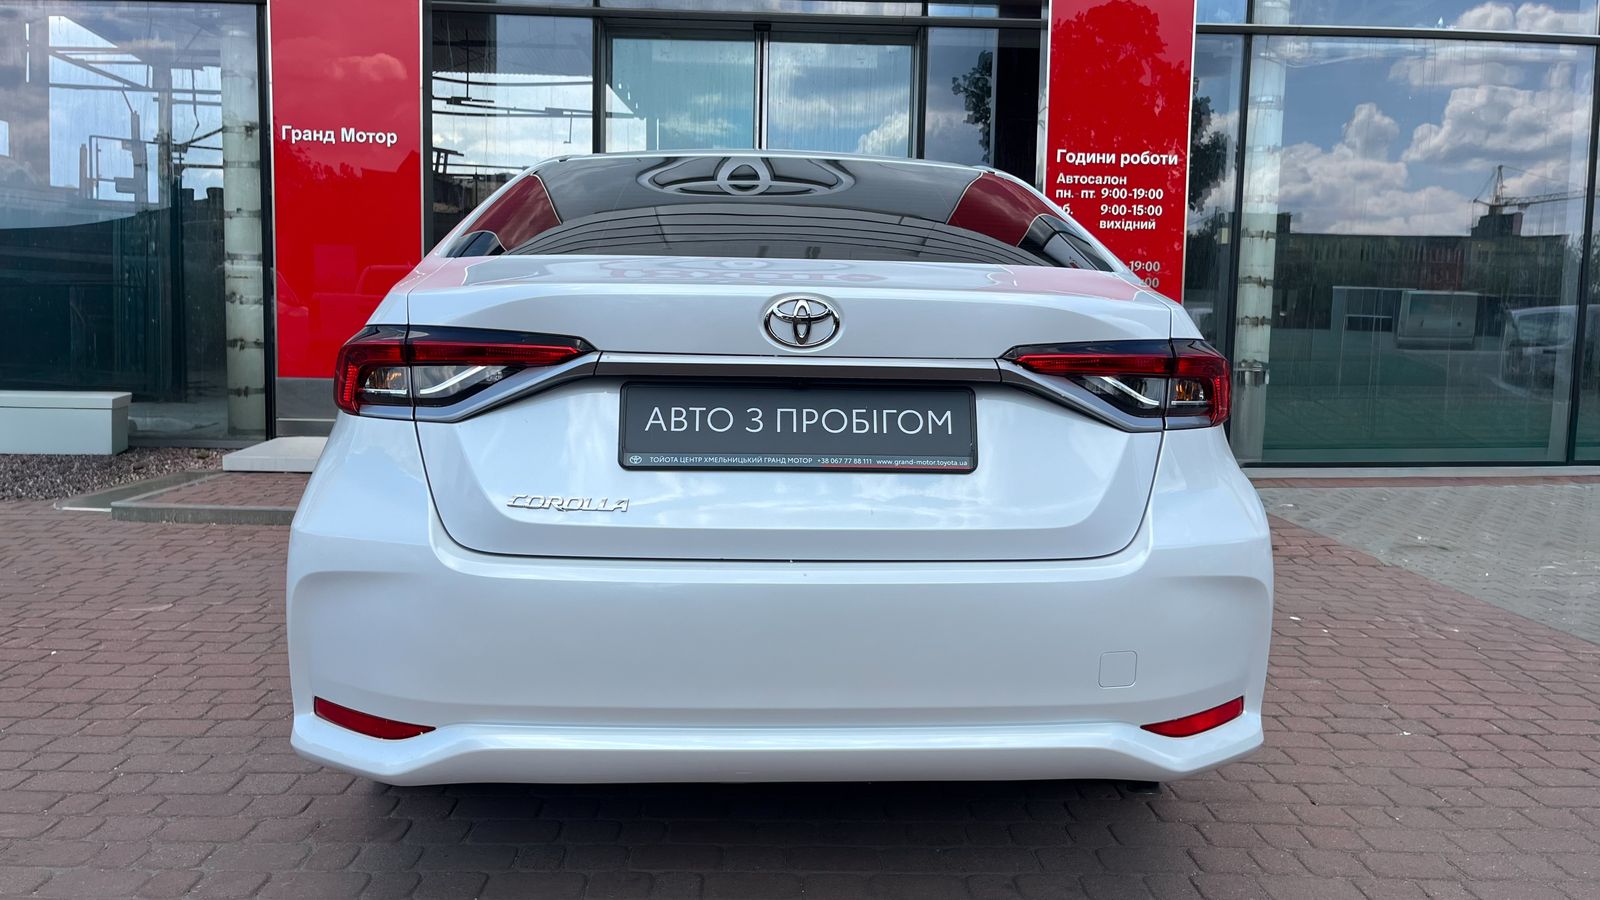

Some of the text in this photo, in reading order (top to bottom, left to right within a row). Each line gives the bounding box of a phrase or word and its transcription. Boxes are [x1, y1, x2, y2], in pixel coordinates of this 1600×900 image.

[281, 125, 398, 147] Гранд Мотор
[1056, 149, 1178, 167] Години роботи
[1056, 173, 1127, 185] Автосалон
[1055, 188, 1164, 199] пн. пт. 9:00-19:00
[1100, 204, 1163, 216] 9:00-15:00
[1099, 219, 1156, 231] вихідний
[644, 406, 734, 433] АВТО
[776, 408, 952, 435] ПРОБІГОМ
[679, 456, 703, 464] ЦЕНТР
[703, 456, 763, 464] ХМЕЛЬНИЦЬКИЙ
[763, 457, 787, 465] ГРАНД
[787, 457, 813, 465] МОТОР
[830, 457, 843, 465] 067
[843, 457, 853, 465] 77
[853, 457, 863, 465] 88
[876, 459, 968, 467] www.grand-motor.toyota.ua
[507, 495, 630, 512] COROLLA
